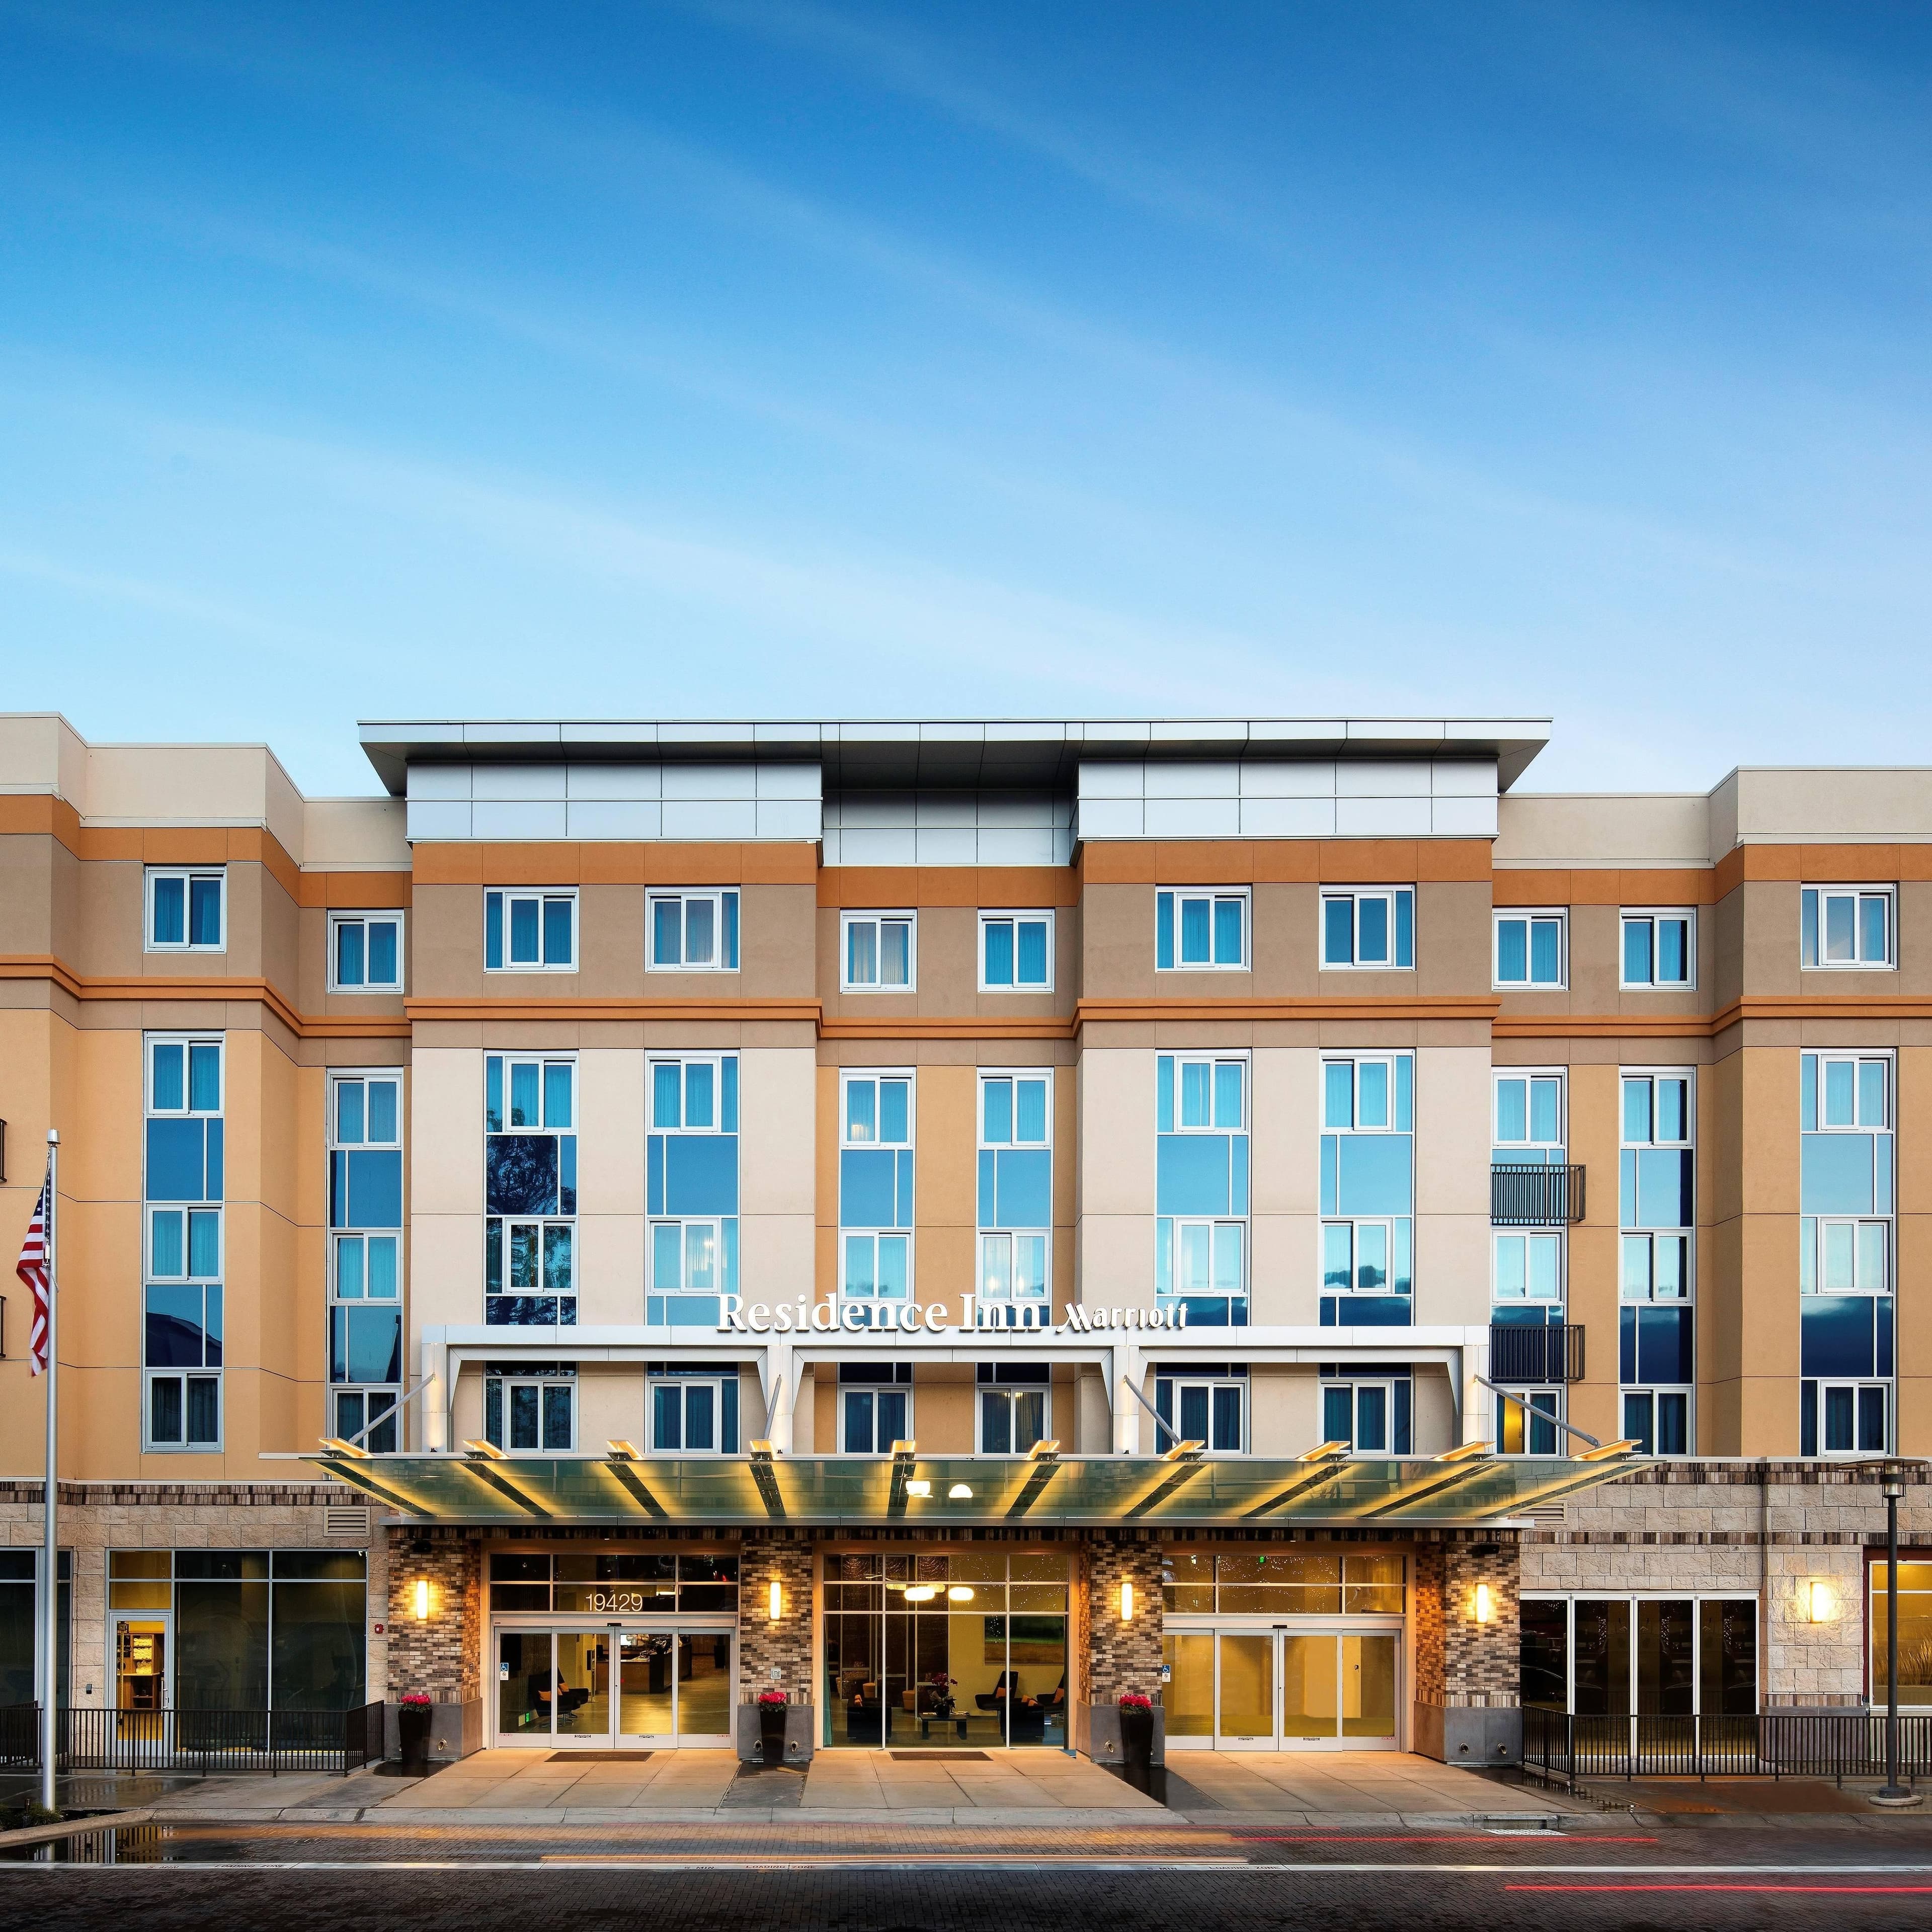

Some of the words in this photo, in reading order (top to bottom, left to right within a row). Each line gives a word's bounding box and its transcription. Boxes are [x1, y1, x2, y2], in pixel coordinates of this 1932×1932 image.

[716, 1292, 948, 1332] Residence
[959, 1293, 1043, 1332] Inn
[1056, 1302, 1189, 1333] Marriott
[585, 1593, 643, 1612] 19429
